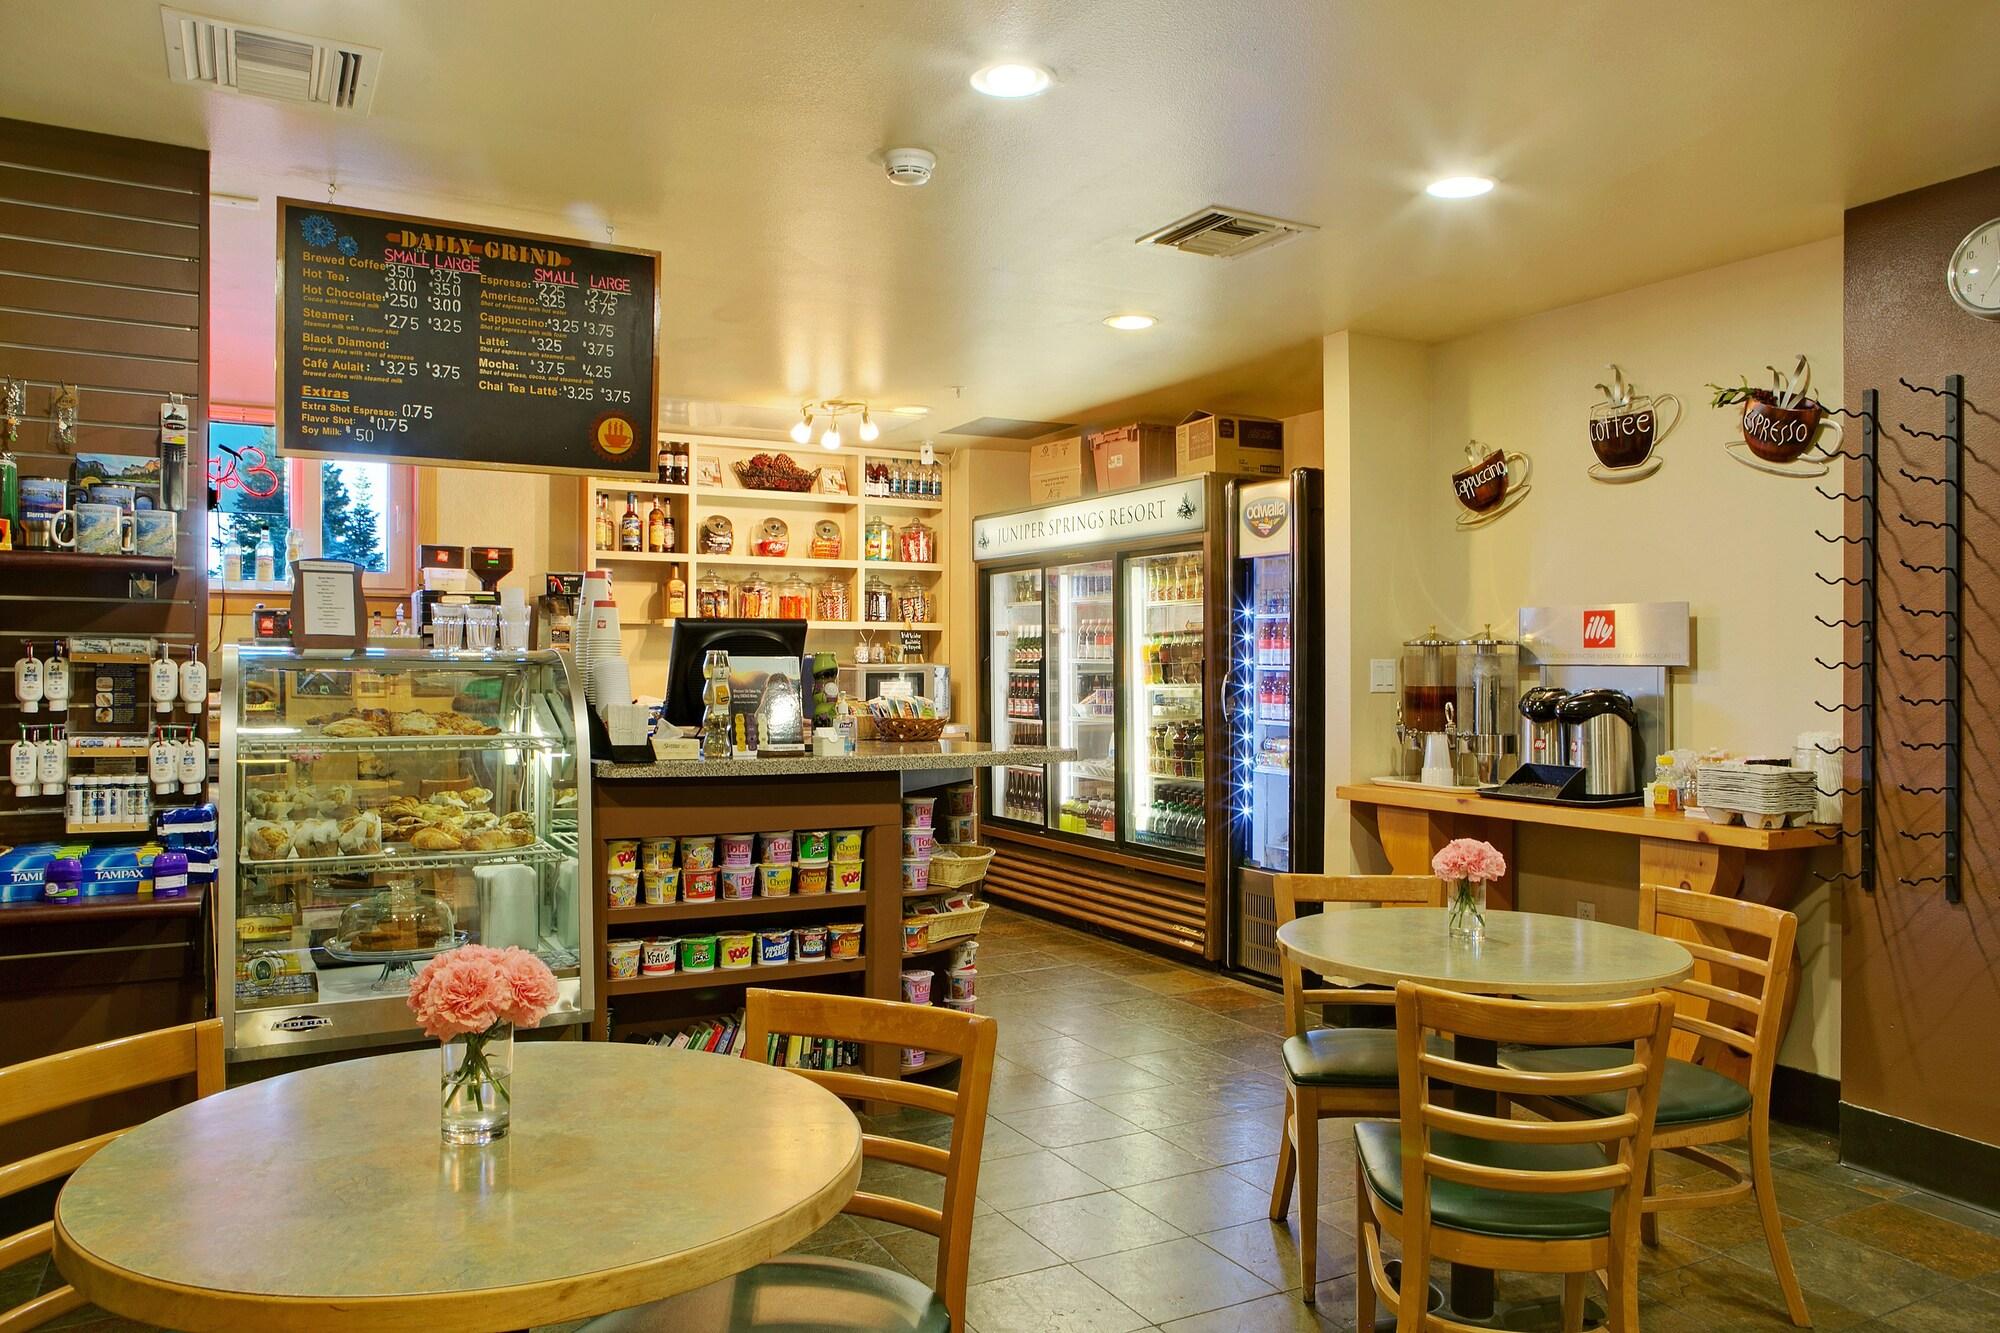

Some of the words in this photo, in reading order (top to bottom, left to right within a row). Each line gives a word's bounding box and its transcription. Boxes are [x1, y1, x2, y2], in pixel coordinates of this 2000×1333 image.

[401, 230, 474, 256] DAILY
[484, 241, 561, 268] GRIND
[1966, 250, 1974, 260] 10
[303, 252, 345, 266] Brewed
[384, 248, 430, 267] SMALL
[435, 253, 480, 273] LARGE
[303, 267, 322, 281] Hot
[326, 269, 350, 283] Tea:
[480, 274, 531, 289] Espresso:
[534, 268, 578, 286] SMALL
[590, 273, 631, 292] LARGE
[303, 284, 322, 296] Hot
[326, 287, 386, 302] Chocolate:
[480, 289, 538, 305] Americano:
[303, 307, 354, 321] Steamer:
[479, 312, 547, 328] Cappuccino:
[303, 333, 333, 346] Black
[337, 336, 390, 350] Diamond:
[303, 357, 328, 369] Café
[479, 358, 519, 371] Mocha:
[302, 385, 350, 400] Extras
[479, 380, 503, 392] Chai
[507, 382, 526, 394] Tea
[302, 402, 327, 412] Extra
[329, 403, 351, 414] Shot
[353, 405, 398, 419] Espresso:
[402, 404, 433, 420] 0.75
[302, 413, 329, 424] Flavor
[332, 415, 356, 426] Shot:
[1744, 409, 1808, 446] ESPRESSO
[302, 425, 320, 437] Soy
[322, 426, 342, 437] Milk:
[1246, 501, 1286, 519] odwalla
[998, 521, 1046, 545] JUNIPER
[1049, 511, 1105, 536] SPRINGS
[1110, 500, 1166, 526] RESORT
[1584, 615, 1614, 645] illy
[95, 869, 144, 880] TAMPAX
[728, 946, 750, 963] POPS
